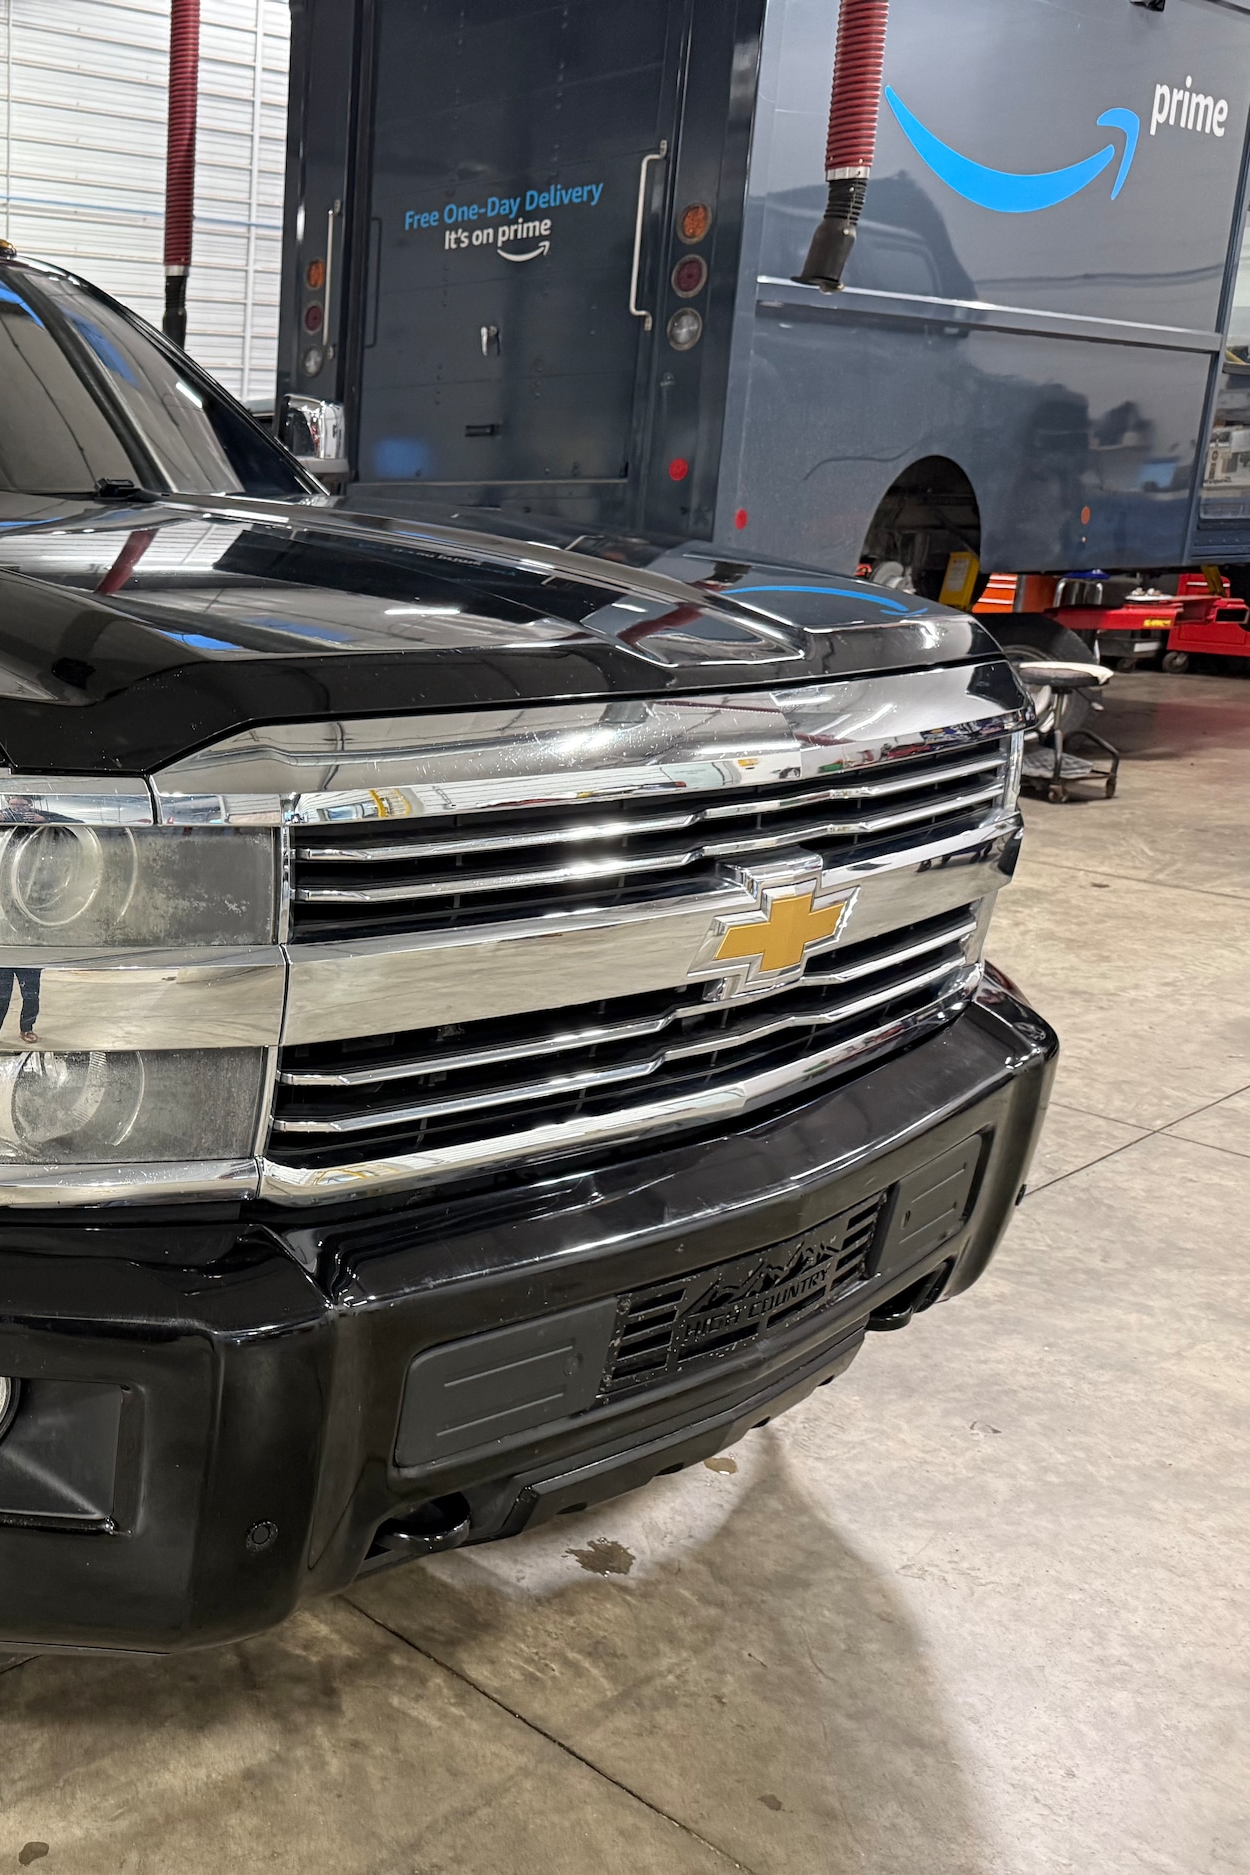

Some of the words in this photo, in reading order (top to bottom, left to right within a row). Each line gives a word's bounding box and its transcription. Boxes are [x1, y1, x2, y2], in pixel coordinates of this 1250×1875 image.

[1149, 75, 1229, 137] prime
[404, 210, 440, 231] Free
[443, 196, 521, 225] One-Day
[525, 182, 604, 212] Delivery
[472, 226, 494, 246] on
[497, 217, 552, 247] prime
[685, 1311, 740, 1339] HIGH
[747, 1264, 831, 1321] COUNTRY
